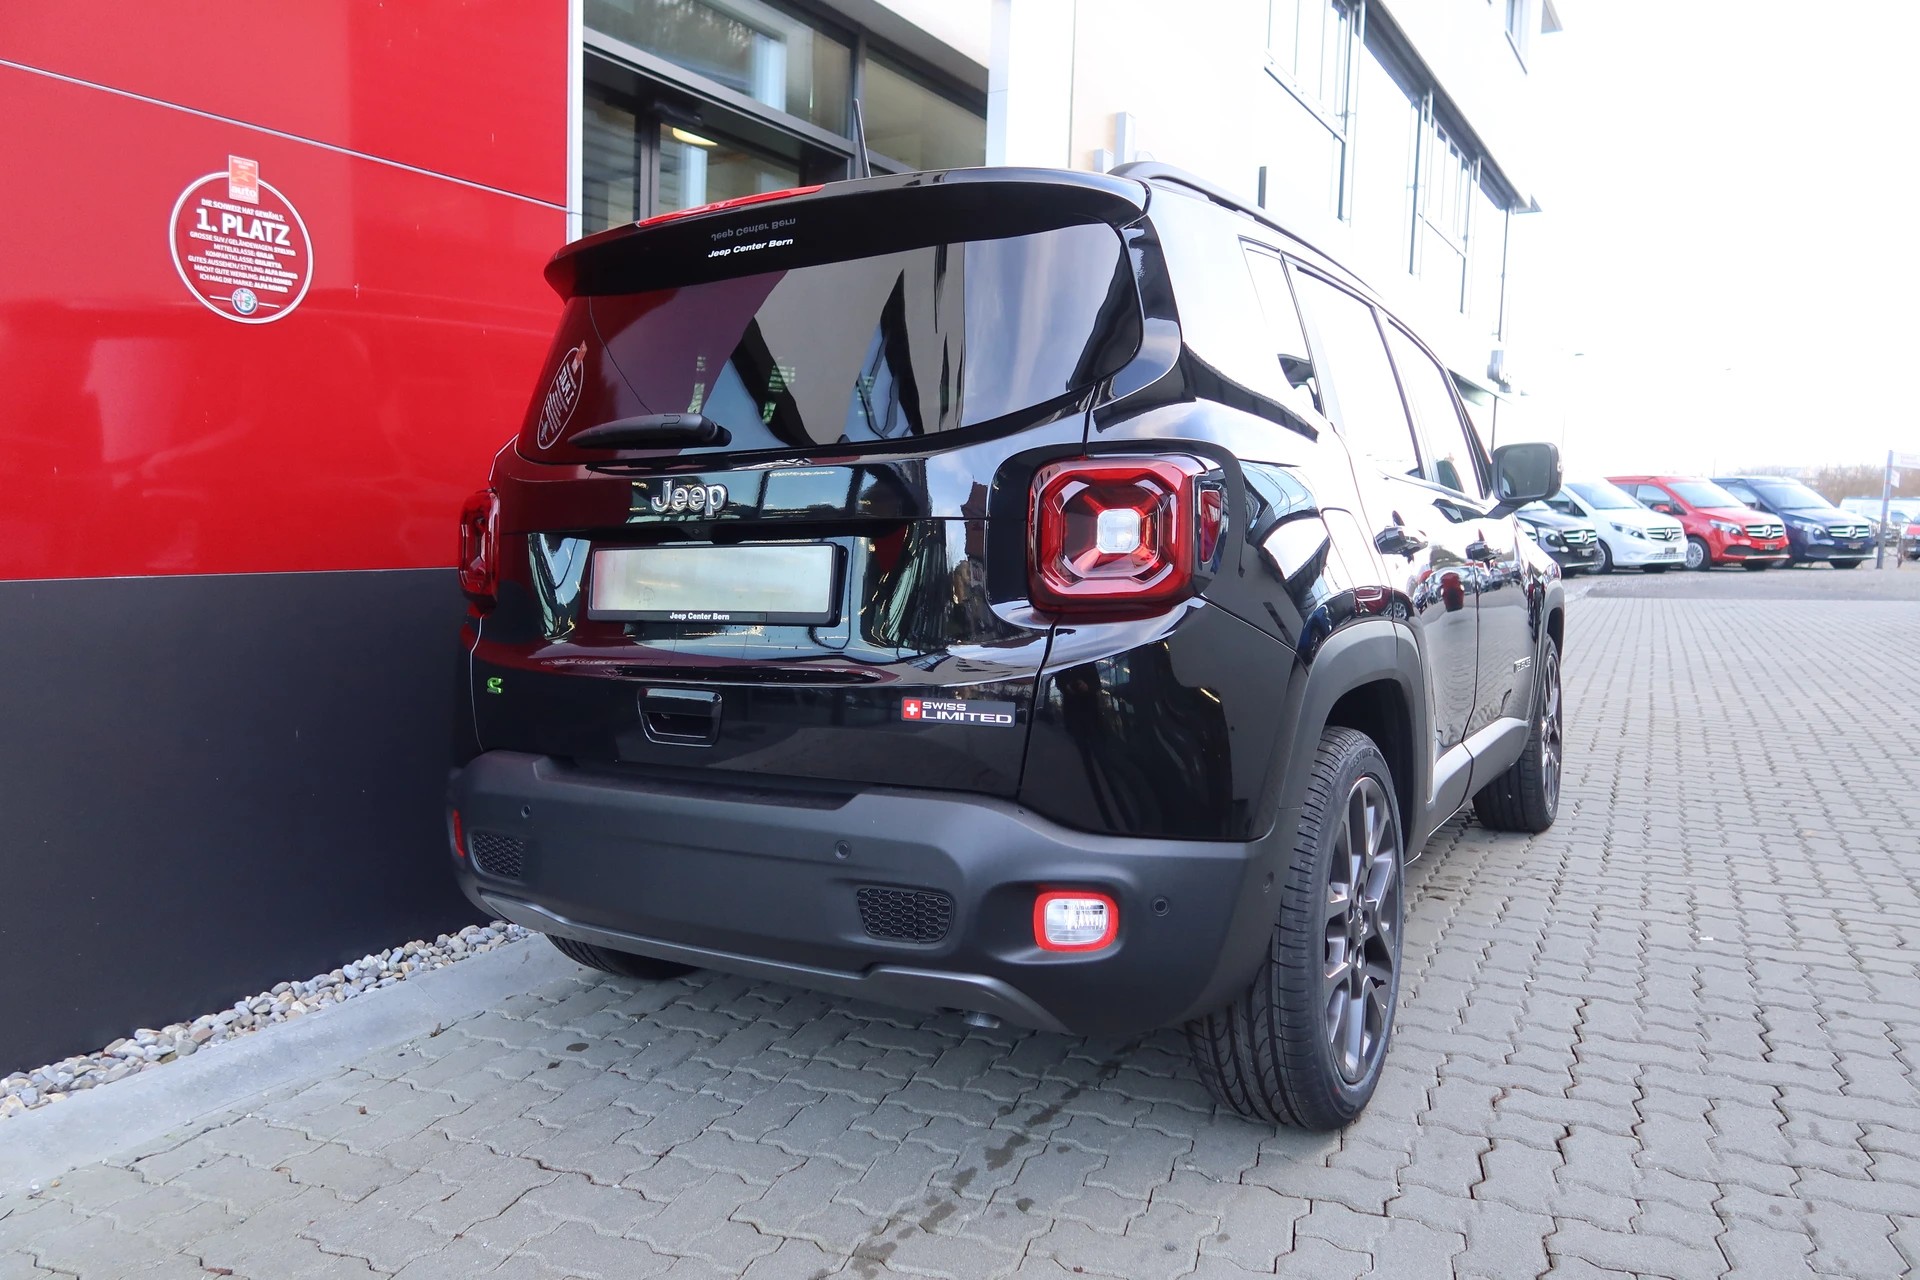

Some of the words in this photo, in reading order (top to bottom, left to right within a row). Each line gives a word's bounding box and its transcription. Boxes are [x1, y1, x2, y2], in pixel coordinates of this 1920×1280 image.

[212, 200, 241, 212] SCHWEIZ
[196, 208, 218, 233] 1.
[222, 212, 290, 246] PLATZ
[708, 248, 731, 258] Jeep
[733, 242, 767, 253] Center
[768, 238, 794, 248] Bern
[651, 478, 729, 518] Jeep
[670, 612, 686, 620] Jeep
[688, 612, 711, 620] Center
[713, 612, 730, 620] Bern
[922, 701, 967, 711] SWISS
[921, 710, 1013, 724] LIMITED
